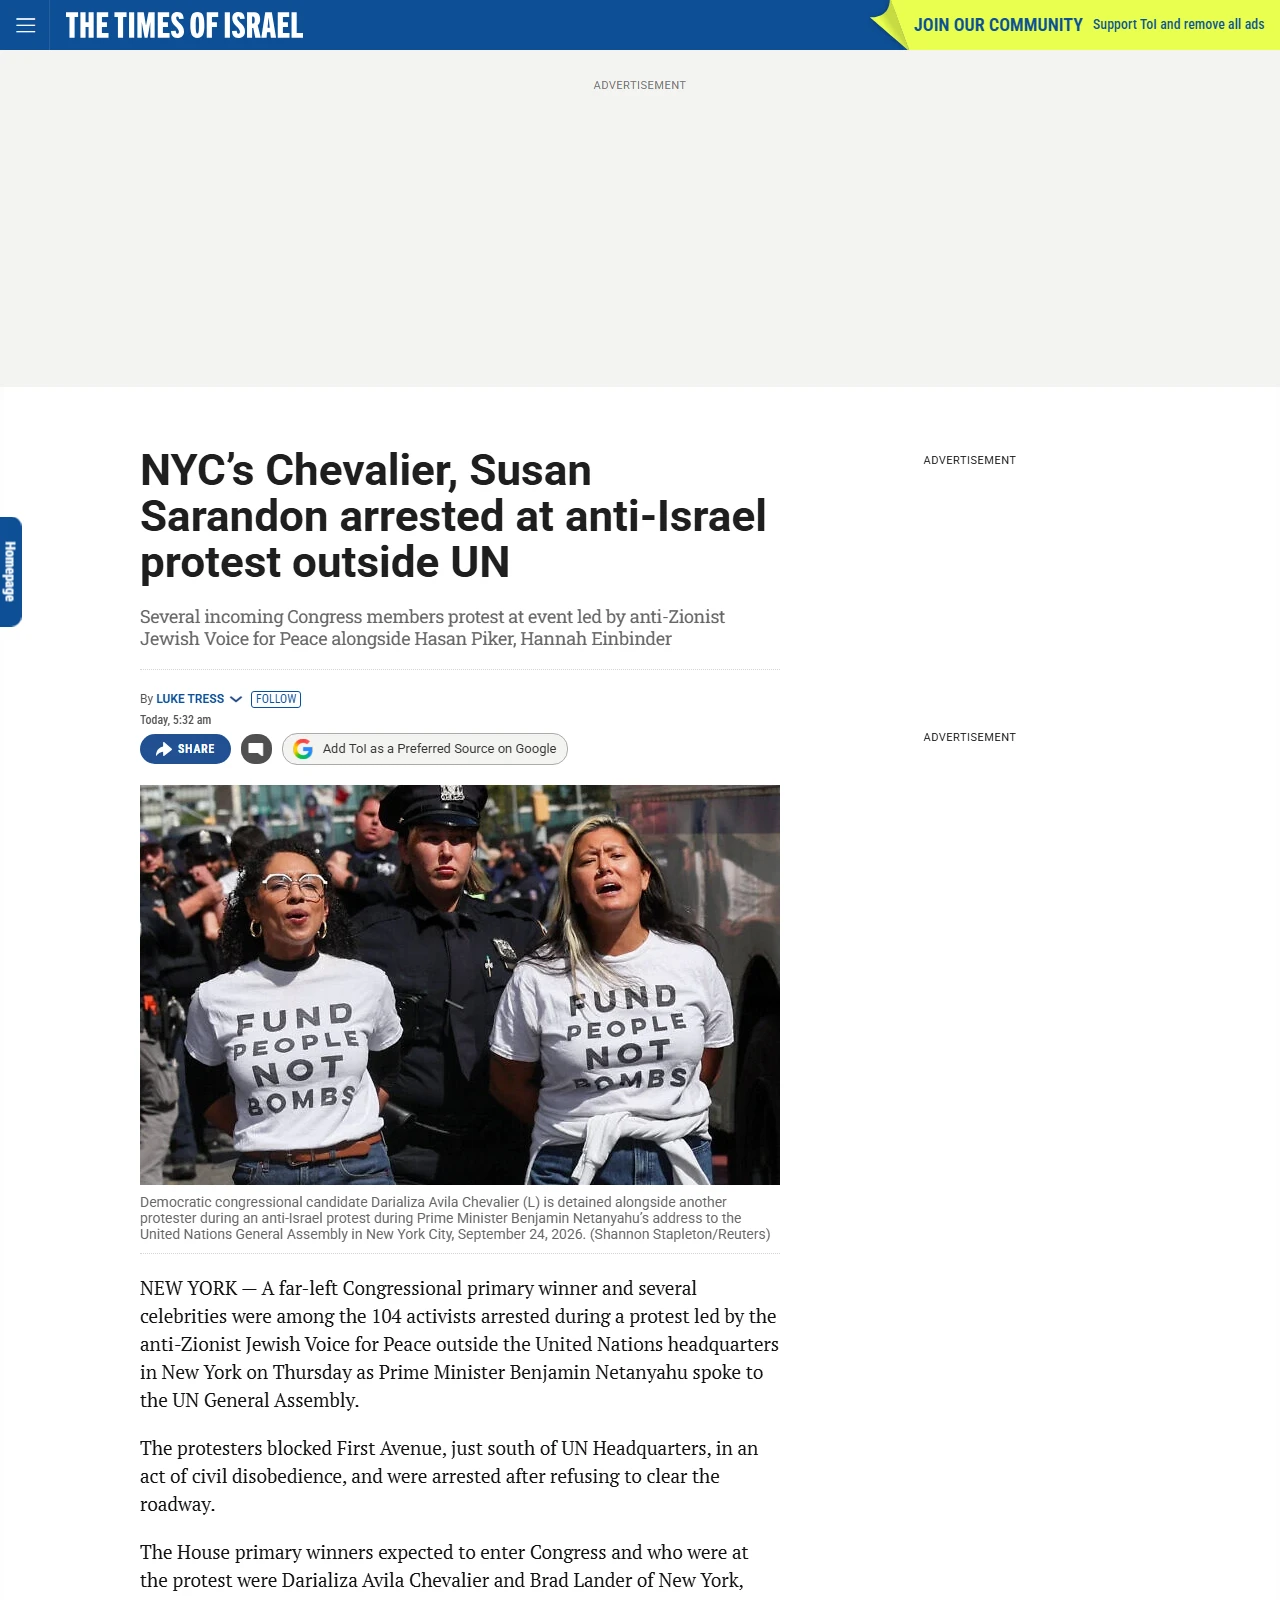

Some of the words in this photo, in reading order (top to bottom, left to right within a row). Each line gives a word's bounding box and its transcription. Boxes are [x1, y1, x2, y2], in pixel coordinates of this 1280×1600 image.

[65, 11, 109, 39] THE
[113, 11, 184, 39] TIMES
[189, 11, 218, 39] OF
[223, 11, 303, 39] ISRAEL
[913, 16, 949, 33] JOIN
[953, 16, 984, 33] OUR
[988, 16, 1083, 33] COMMUNITY
[1092, 17, 1137, 33] Support
[1139, 17, 1156, 31] ToI
[1159, 17, 1180, 31] and
[1183, 19, 1225, 31] remove
[1227, 17, 1241, 31] all
[1244, 17, 1264, 31] ads
[593, 80, 686, 90] ADVERTISEMENT
[923, 455, 1016, 465] ADVERTISEMENT
[142, 451, 253, 486] NYC’s
[266, 451, 456, 494] Chevalier,
[470, 453, 590, 486] Susan
[140, 497, 326, 532] Sarandon
[340, 497, 502, 532] arrested
[516, 501, 553, 532] at
[565, 497, 765, 532] anti-Israel
[2, 541, 16, 602] Homepage
[141, 547, 281, 587] protest
[292, 543, 438, 578] outside
[452, 545, 508, 578] UN
[140, 608, 200, 624] Several
[204, 608, 284, 628] incoming
[287, 609, 362, 628] Congress
[366, 608, 444, 624] members
[447, 610, 505, 628] protest
[508, 610, 524, 624] at
[527, 610, 573, 624] event
[576, 608, 602, 624] led
[604, 608, 626, 628] by
[629, 608, 725, 624] anti-Zionist
[139, 630, 200, 646] Jewish
[203, 630, 249, 646] Voice
[252, 630, 276, 646] for
[279, 631, 327, 646] Peace
[331, 630, 410, 650] alongside
[414, 631, 467, 646] Hasan
[470, 630, 516, 649] Piker,
[520, 630, 587, 646] Hannah
[591, 630, 672, 646] Einbinder
[140, 693, 153, 706] By
[156, 693, 185, 704] LUKE
[186, 693, 224, 704] TRESS
[256, 693, 296, 704] FOLLOW
[139, 714, 170, 727] Today,
[172, 714, 194, 725] 5:32
[196, 716, 211, 725] am
[923, 732, 1016, 742] ADVERTISEMENT
[177, 743, 214, 754] SHARE
[322, 742, 345, 754] Add
[348, 743, 366, 754] ToI
[369, 745, 384, 754] as
[386, 745, 394, 754] a
[397, 742, 450, 754] Preferred
[454, 743, 494, 754] Source
[497, 745, 512, 754] on
[515, 742, 556, 757] Google
[569, 984, 676, 1017] FUND
[236, 1002, 353, 1037] FUND
[566, 1012, 687, 1042] PEOPLE
[232, 1030, 360, 1062] PEOPLE
[585, 1038, 671, 1071] NOT
[251, 1054, 344, 1088] NOT
[247, 1085, 356, 1117] BOMBS
[140, 1195, 211, 1208] Democratic
[214, 1195, 302, 1211] congressional
[305, 1195, 367, 1208] candidate
[371, 1195, 424, 1208] Darializa
[428, 1195, 458, 1208] Avila
[462, 1195, 519, 1208] Chevalier
[522, 1195, 539, 1211] (L)
[543, 1195, 554, 1208] is
[557, 1195, 611, 1208] detained
[614, 1195, 675, 1211] alongside
[678, 1195, 727, 1208] another
[140, 1213, 197, 1227] protester
[199, 1211, 239, 1227] during
[242, 1214, 257, 1224] an
[261, 1211, 322, 1224] anti-Israel
[326, 1213, 370, 1227] protest
[373, 1211, 413, 1227] during
[417, 1212, 453, 1224] Prime
[457, 1211, 508, 1224] Minister
[511, 1211, 569, 1227] Benjamin
[573, 1211, 649, 1227] Netanyahu’s
[652, 1211, 702, 1224] address
[704, 1213, 718, 1224] to
[720, 1211, 741, 1224] the
[140, 1227, 179, 1240] United
[183, 1227, 232, 1240] Nations
[235, 1227, 283, 1240] General
[286, 1227, 348, 1243] Assembly
[351, 1227, 362, 1240] in
[366, 1228, 394, 1240] New
[396, 1227, 425, 1240] York
[428, 1227, 454, 1243] City,
[457, 1227, 526, 1243] September
[529, 1228, 547, 1242] 24,
[551, 1228, 585, 1240] 2026.
[589, 1227, 649, 1243] (Shannon
[652, 1227, 770, 1243] Stapleton/Reuters)
[139, 1280, 183, 1296] NEW
[186, 1280, 238, 1296] YORK
[260, 1280, 275, 1296] A
[278, 1279, 338, 1296] far-left
[342, 1279, 462, 1300] Congressional
[466, 1280, 534, 1300] primary
[537, 1280, 598, 1296] winner
[601, 1279, 633, 1296] and
[638, 1279, 697, 1296] several
[139, 1336, 241, 1352] anti-Zionist
[245, 1335, 300, 1355] Jewish
[303, 1336, 349, 1352] Voice
[354, 1335, 379, 1352] for
[382, 1336, 431, 1352] Peace
[436, 1335, 498, 1352] outside
[502, 1335, 530, 1352] the
[534, 1335, 592, 1352] United
[596, 1336, 663, 1352] Nations
[667, 1335, 778, 1356] headquarters
[139, 1439, 172, 1456] The
[176, 1442, 262, 1460] protesters
[266, 1439, 332, 1456] blocked
[336, 1440, 375, 1456] First
[378, 1440, 446, 1459] Avenue,
[450, 1440, 483, 1460] just
[487, 1439, 535, 1456] south
[539, 1439, 558, 1456] of
[560, 1440, 588, 1456] UN
[592, 1439, 711, 1460] Headquarters,
[715, 1440, 733, 1456] in
[737, 1444, 758, 1456] an
[139, 1571, 167, 1588] the
[172, 1574, 233, 1592] protest
[236, 1576, 277, 1588] were
[281, 1571, 358, 1588] Darializa
[361, 1571, 404, 1588] Avila
[409, 1571, 489, 1588] Chevalier
[493, 1571, 525, 1588] and
[529, 1571, 569, 1588] Brad
[573, 1571, 632, 1588] Lander
[636, 1571, 655, 1588] of
[658, 1572, 696, 1588] New
[699, 1571, 743, 1591] York,
